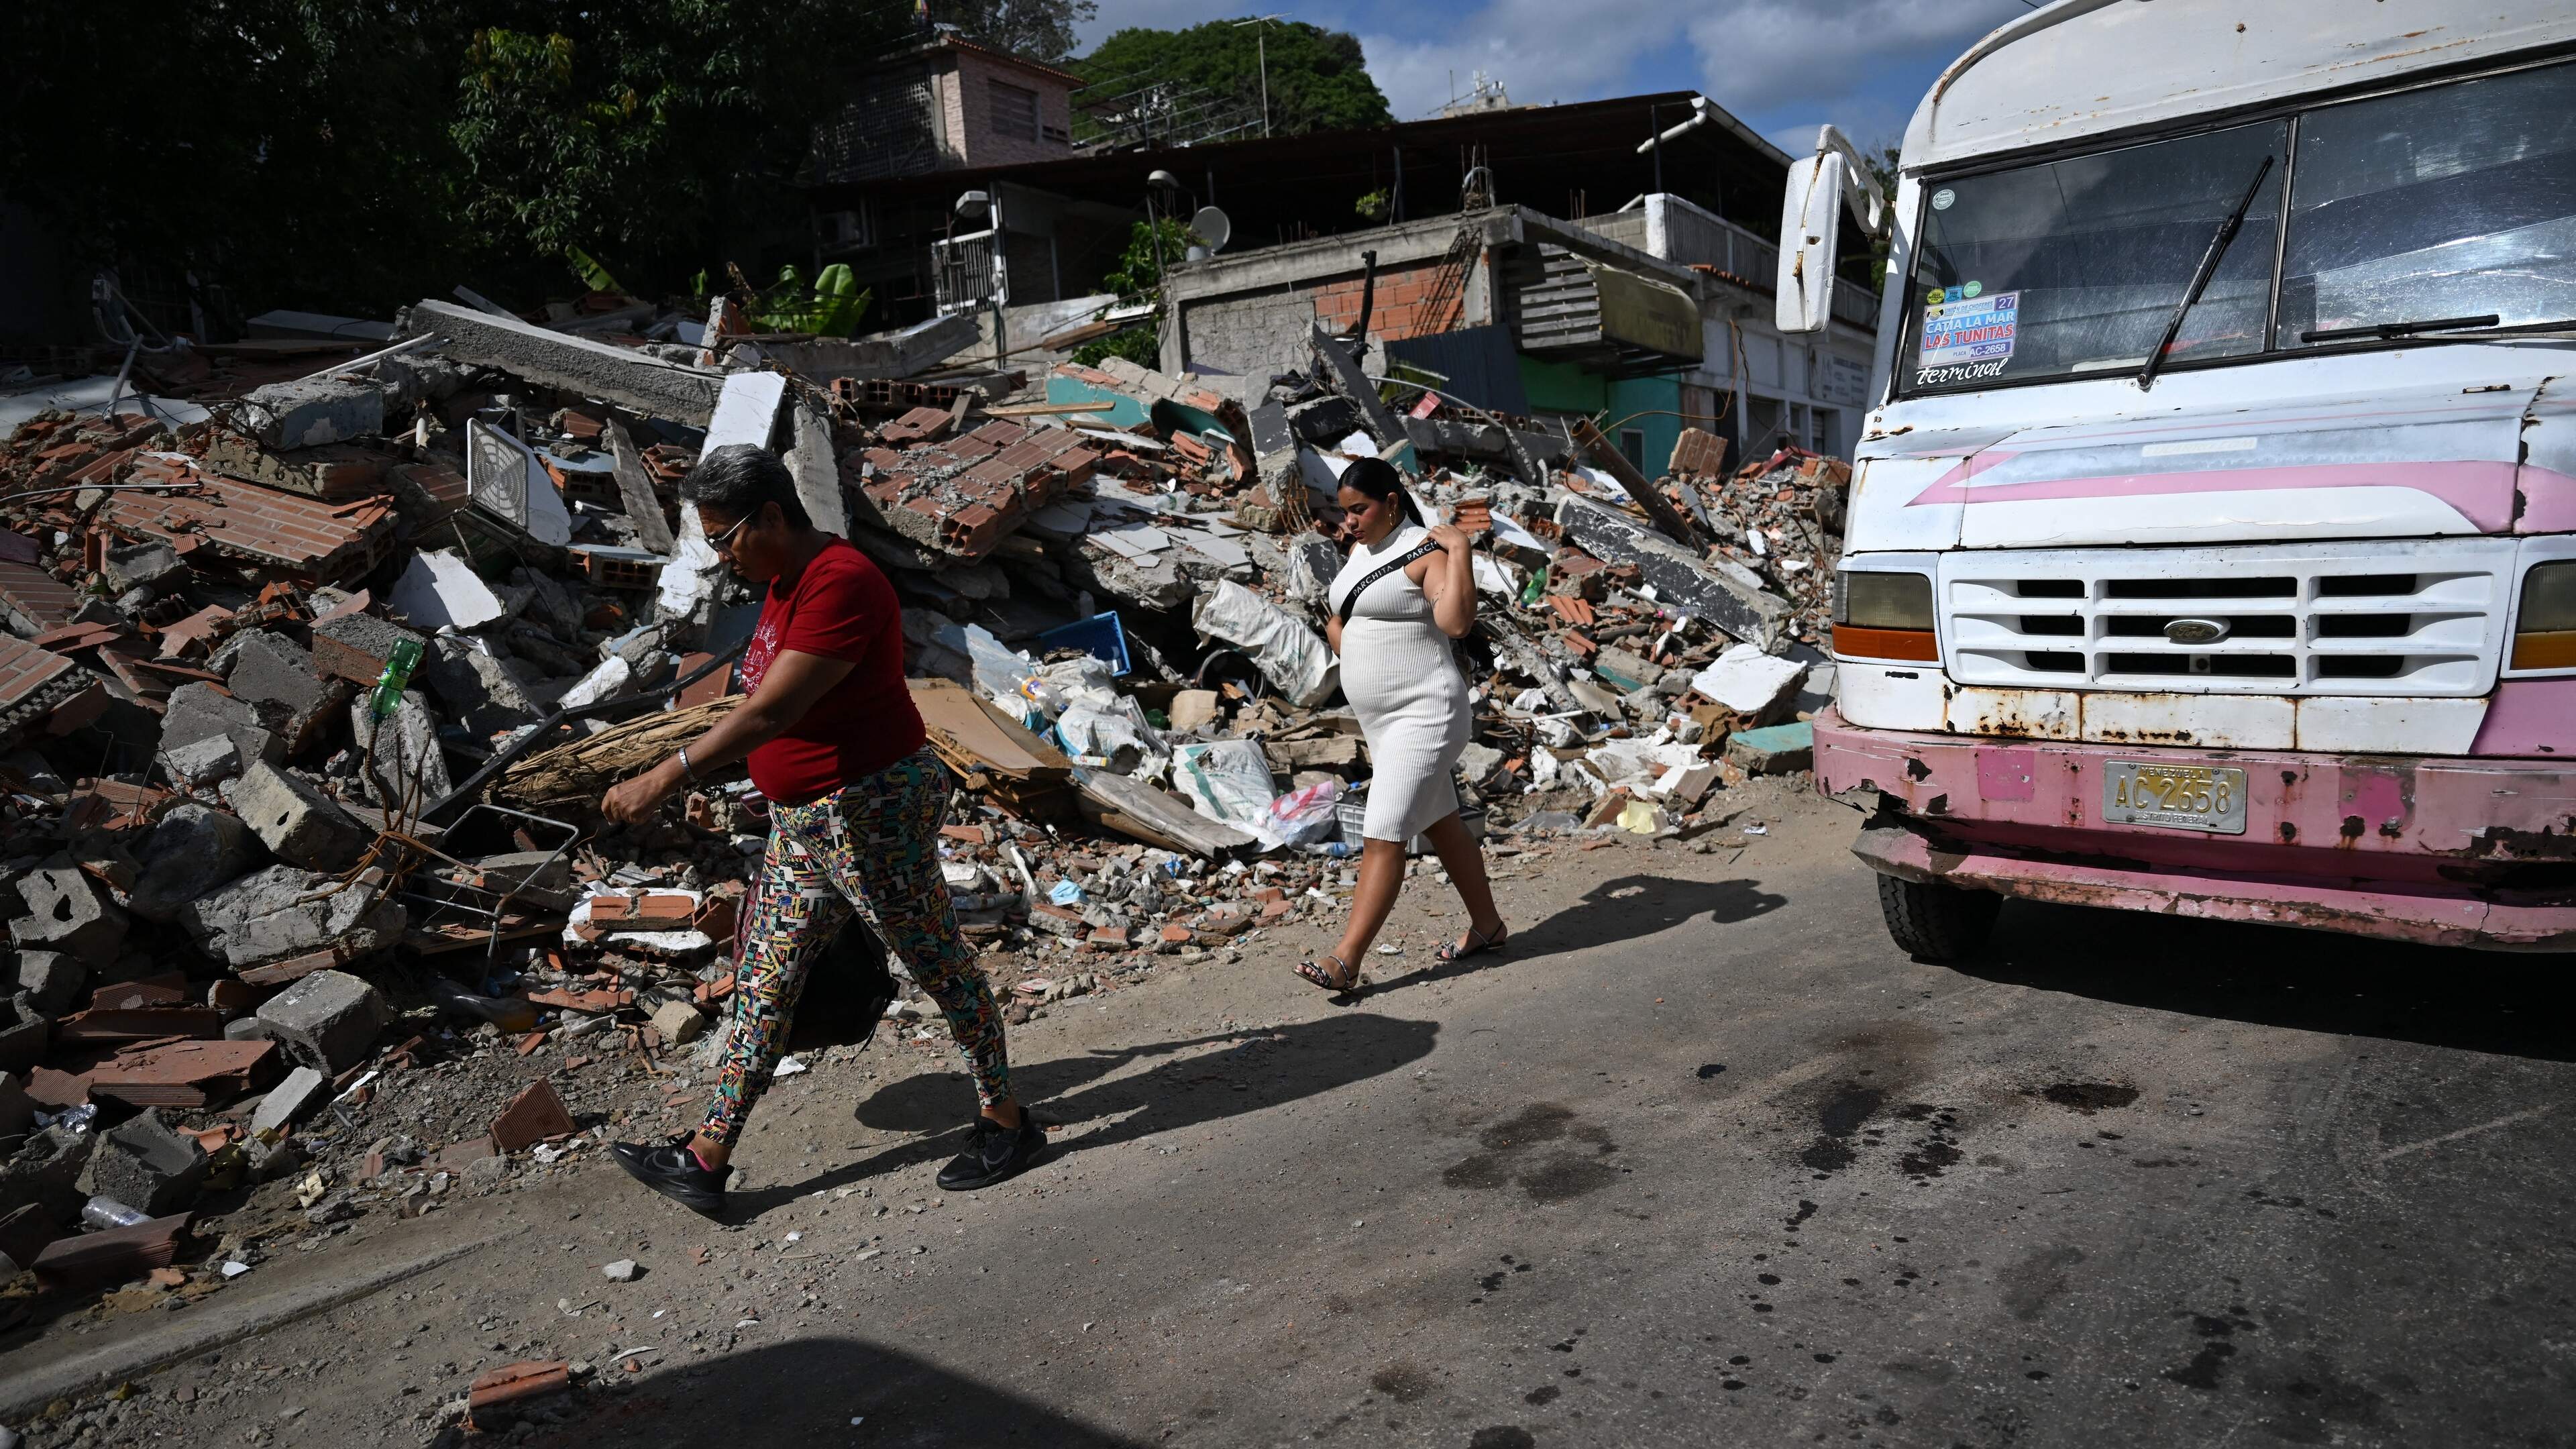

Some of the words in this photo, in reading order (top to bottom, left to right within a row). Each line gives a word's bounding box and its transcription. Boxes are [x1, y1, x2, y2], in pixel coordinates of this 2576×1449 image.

[1968, 301, 1994, 310] CHOFERES
[1998, 297, 2014, 309] 27
[1926, 319, 1963, 334] CATIA
[1966, 316, 1982, 328] LA
[1985, 311, 2015, 325] MAR
[1925, 332, 1951, 349] LAS
[1954, 323, 2015, 345] TUNITAS
[1970, 343, 2006, 358] AC-2658
[1352, 565, 1394, 597] PARCHITA
[2141, 767, 2205, 780] VENEZUELA
[2114, 775, 2149, 809] AC
[2159, 778, 2231, 814] 2658
[2135, 810, 2171, 822] DISTRITO
[2172, 812, 2210, 826] FEDERAL
